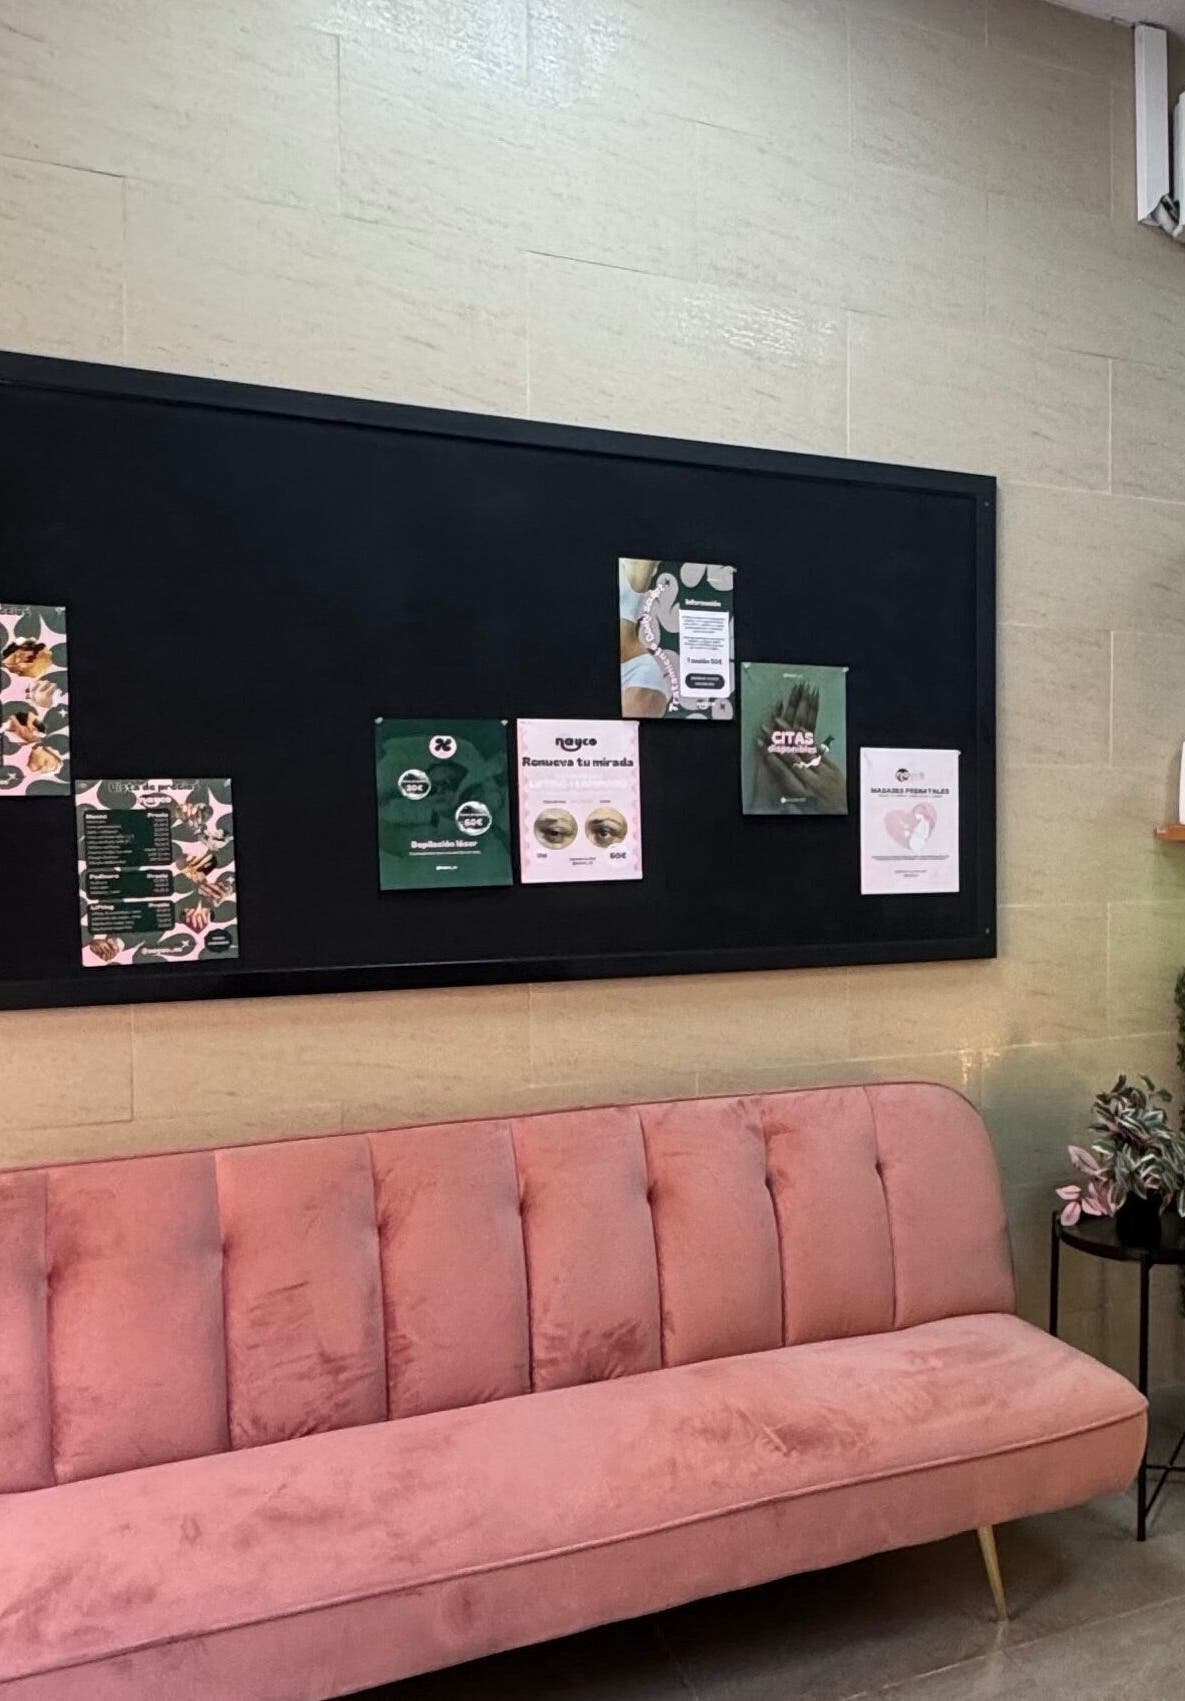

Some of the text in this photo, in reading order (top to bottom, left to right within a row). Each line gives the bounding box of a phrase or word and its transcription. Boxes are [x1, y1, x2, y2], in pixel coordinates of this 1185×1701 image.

[555, 737, 597, 752] nayco
[771, 731, 814, 745] CITAS
[522, 757, 634, 767] Renueva tu mirada
